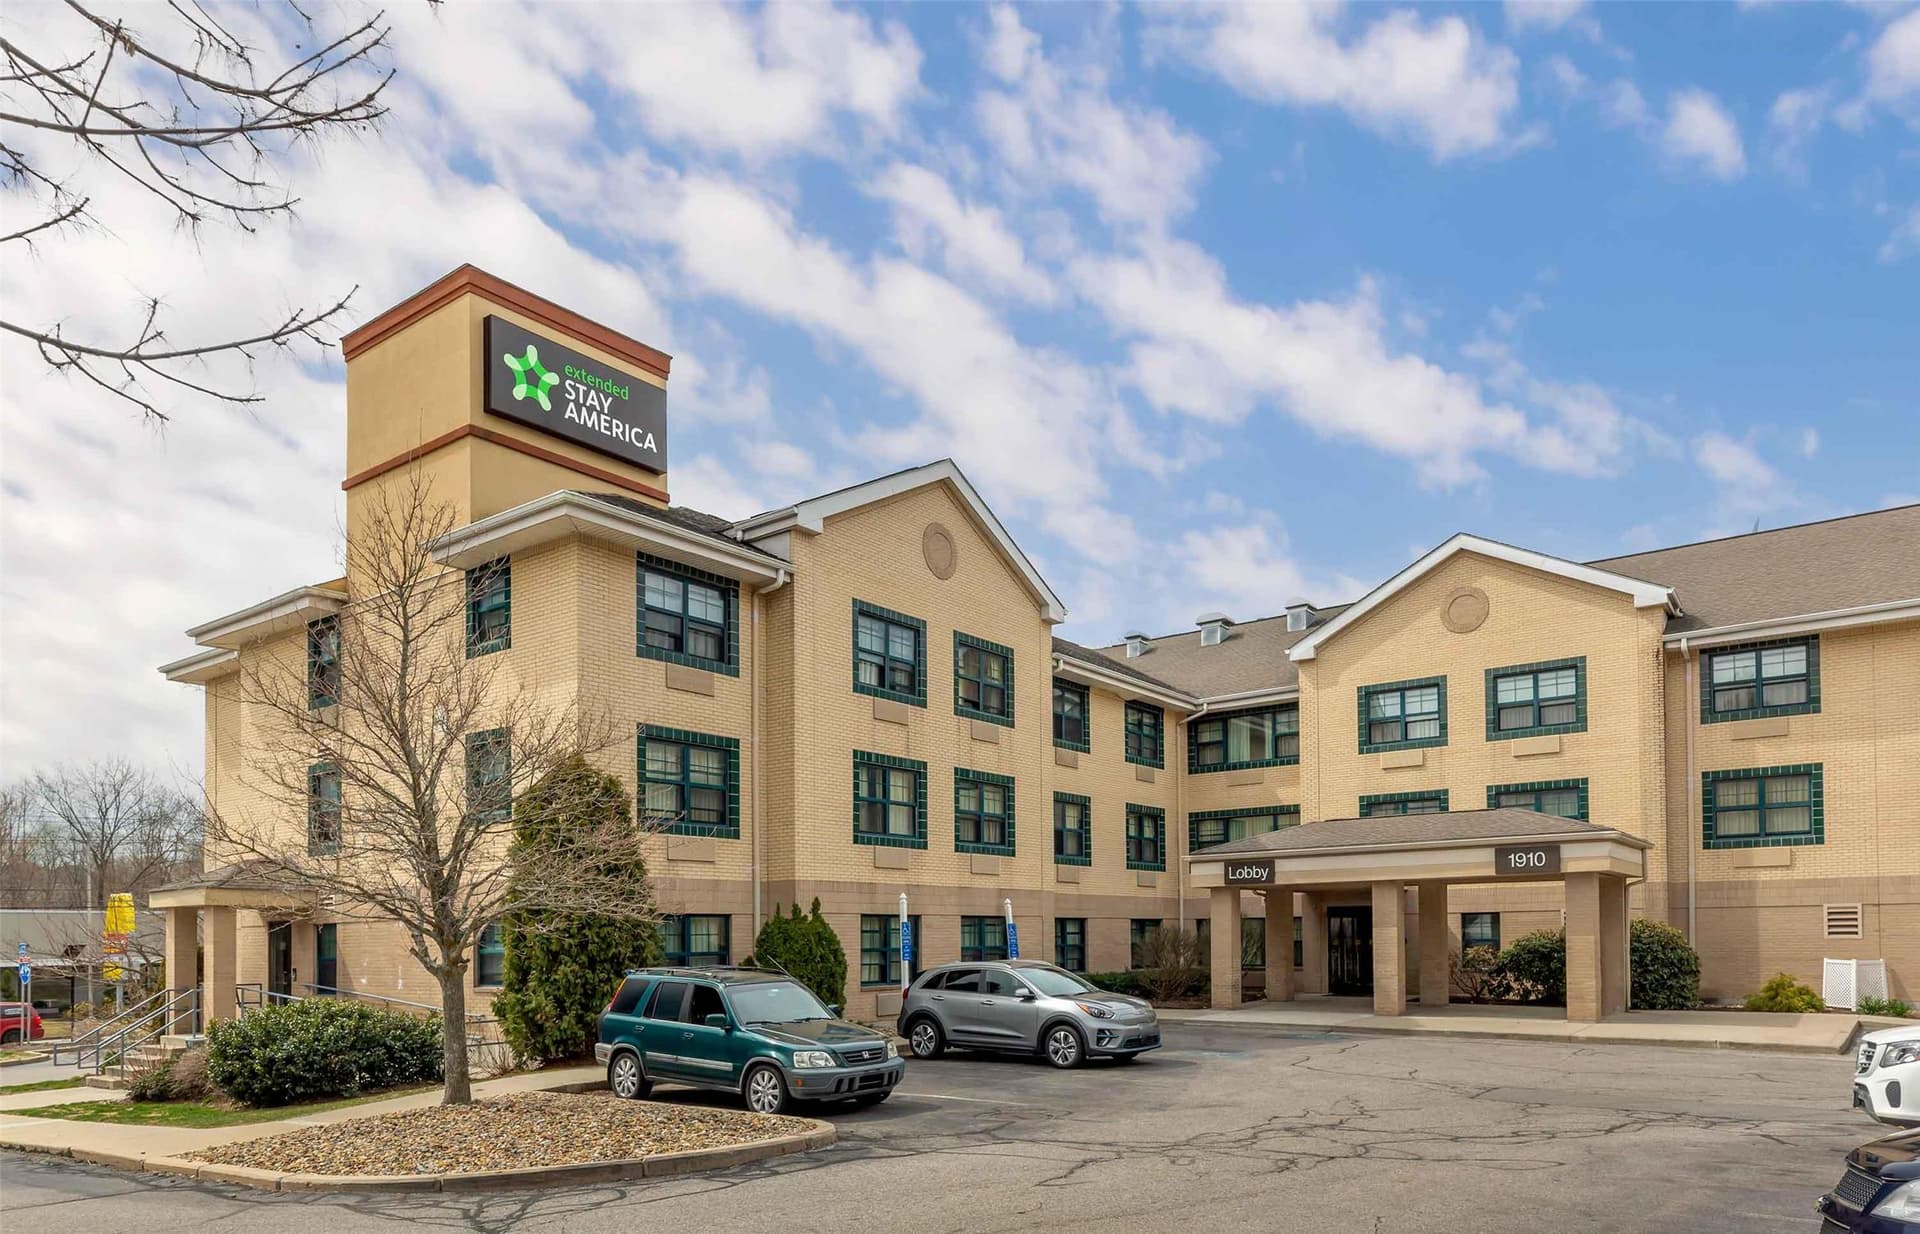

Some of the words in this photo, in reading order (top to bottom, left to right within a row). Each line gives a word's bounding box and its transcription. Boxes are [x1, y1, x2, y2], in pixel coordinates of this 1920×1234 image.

[564, 365, 629, 400] extended
[564, 380, 613, 414] STAY
[564, 402, 657, 453] AMERICA
[1228, 865, 1269, 881] Lobby
[1507, 851, 1546, 868] 1910
